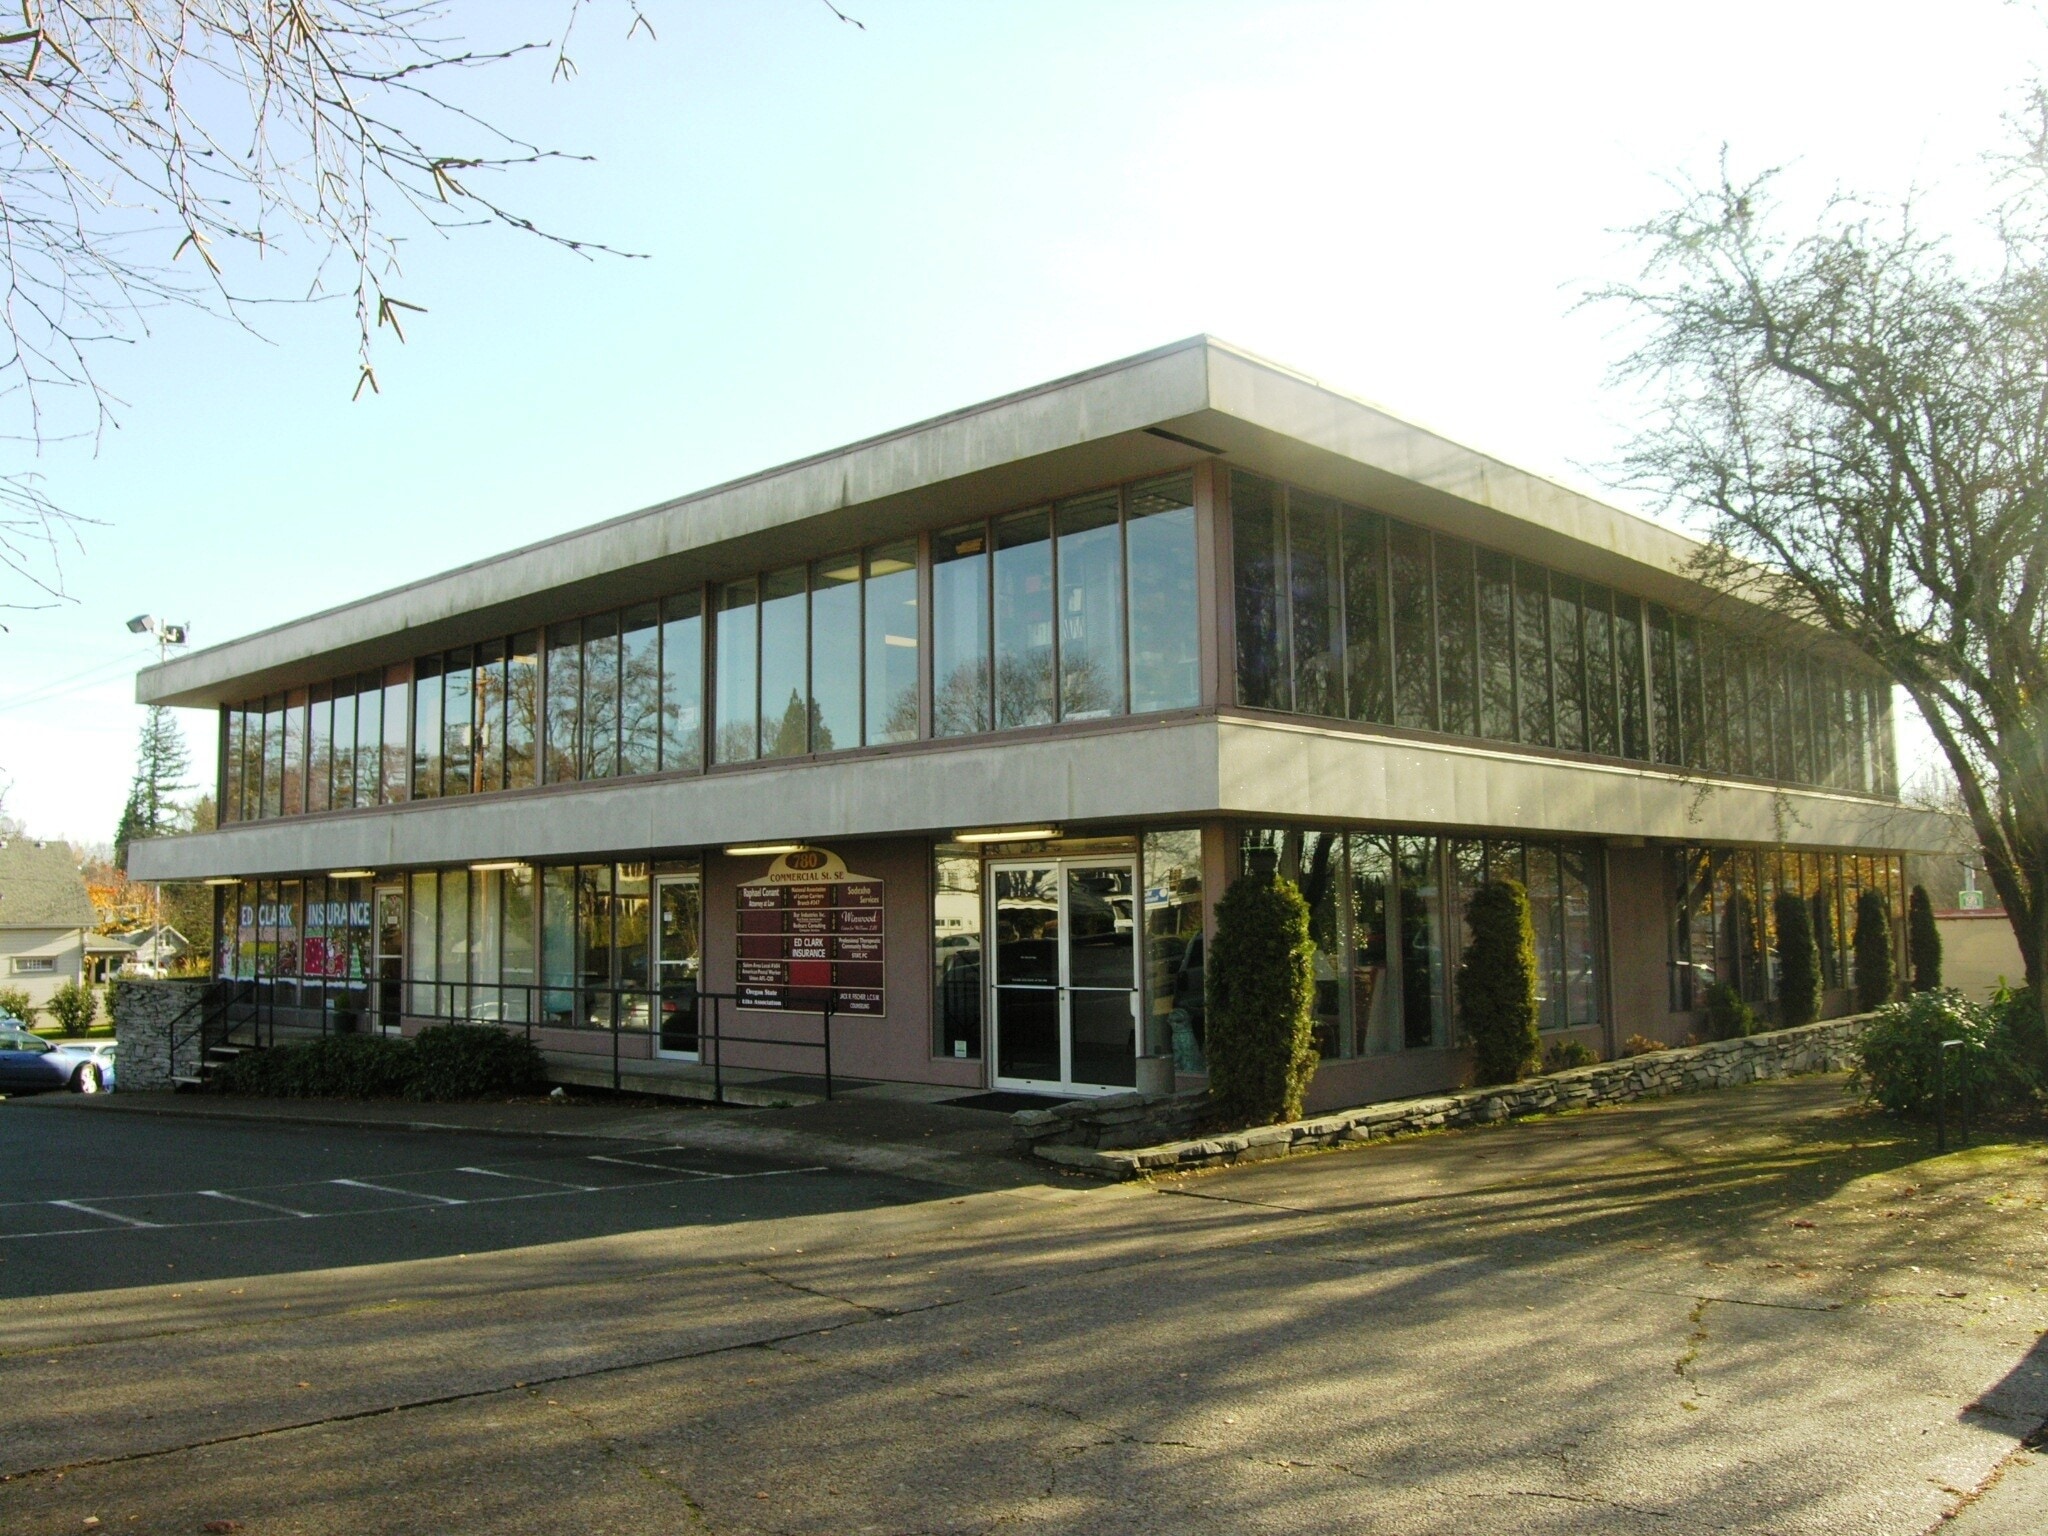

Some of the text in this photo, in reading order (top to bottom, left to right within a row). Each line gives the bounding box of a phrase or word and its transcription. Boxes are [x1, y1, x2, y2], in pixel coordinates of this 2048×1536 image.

[793, 853, 818, 869] 780
[770, 872, 819, 882] COMMERCIAL
[834, 871, 844, 880] SE
[859, 896, 879, 904] Services
[241, 902, 370, 926] ED CLARK INSURANCE
[794, 938, 802, 946] ED
[803, 938, 823, 947] CLARK
[792, 949, 826, 958] INSURANCE
